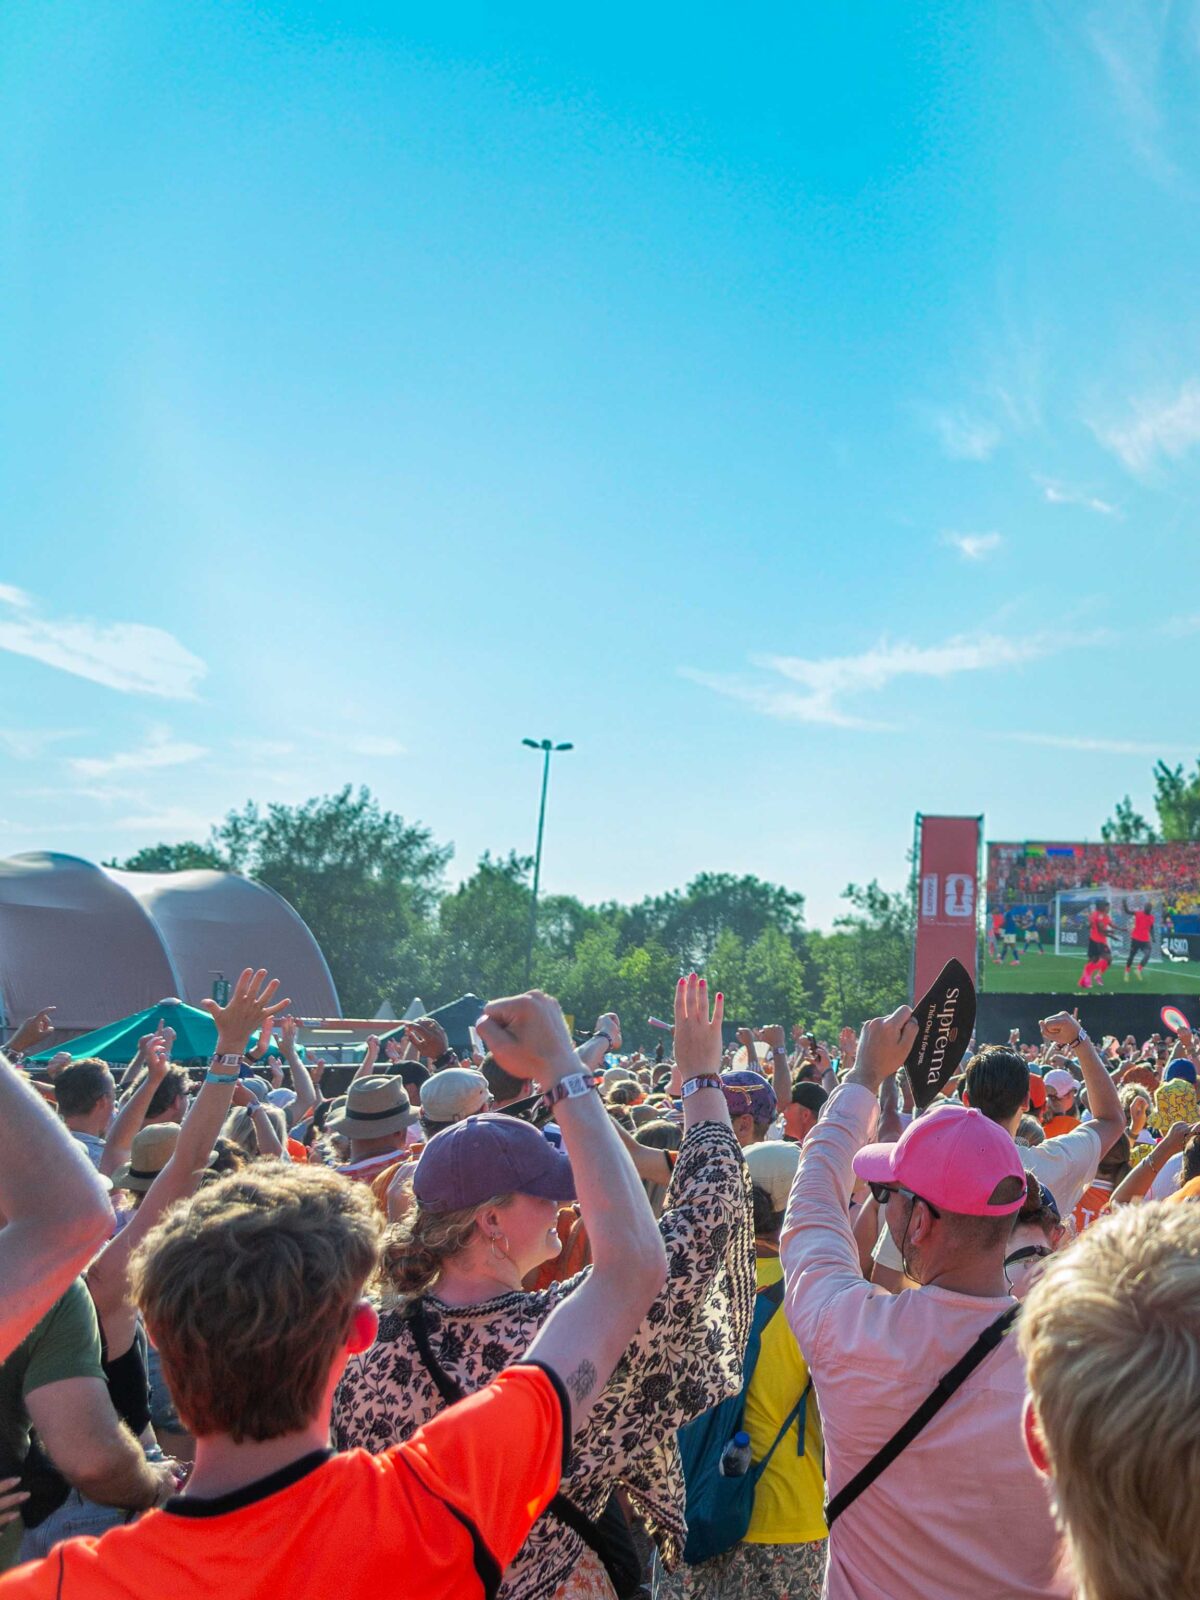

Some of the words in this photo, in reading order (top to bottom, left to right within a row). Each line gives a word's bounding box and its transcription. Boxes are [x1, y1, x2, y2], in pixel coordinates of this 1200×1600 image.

[927, 1003, 937, 1020] This
[925, 1020, 933, 1034] One
[927, 987, 960, 1085] suprema
